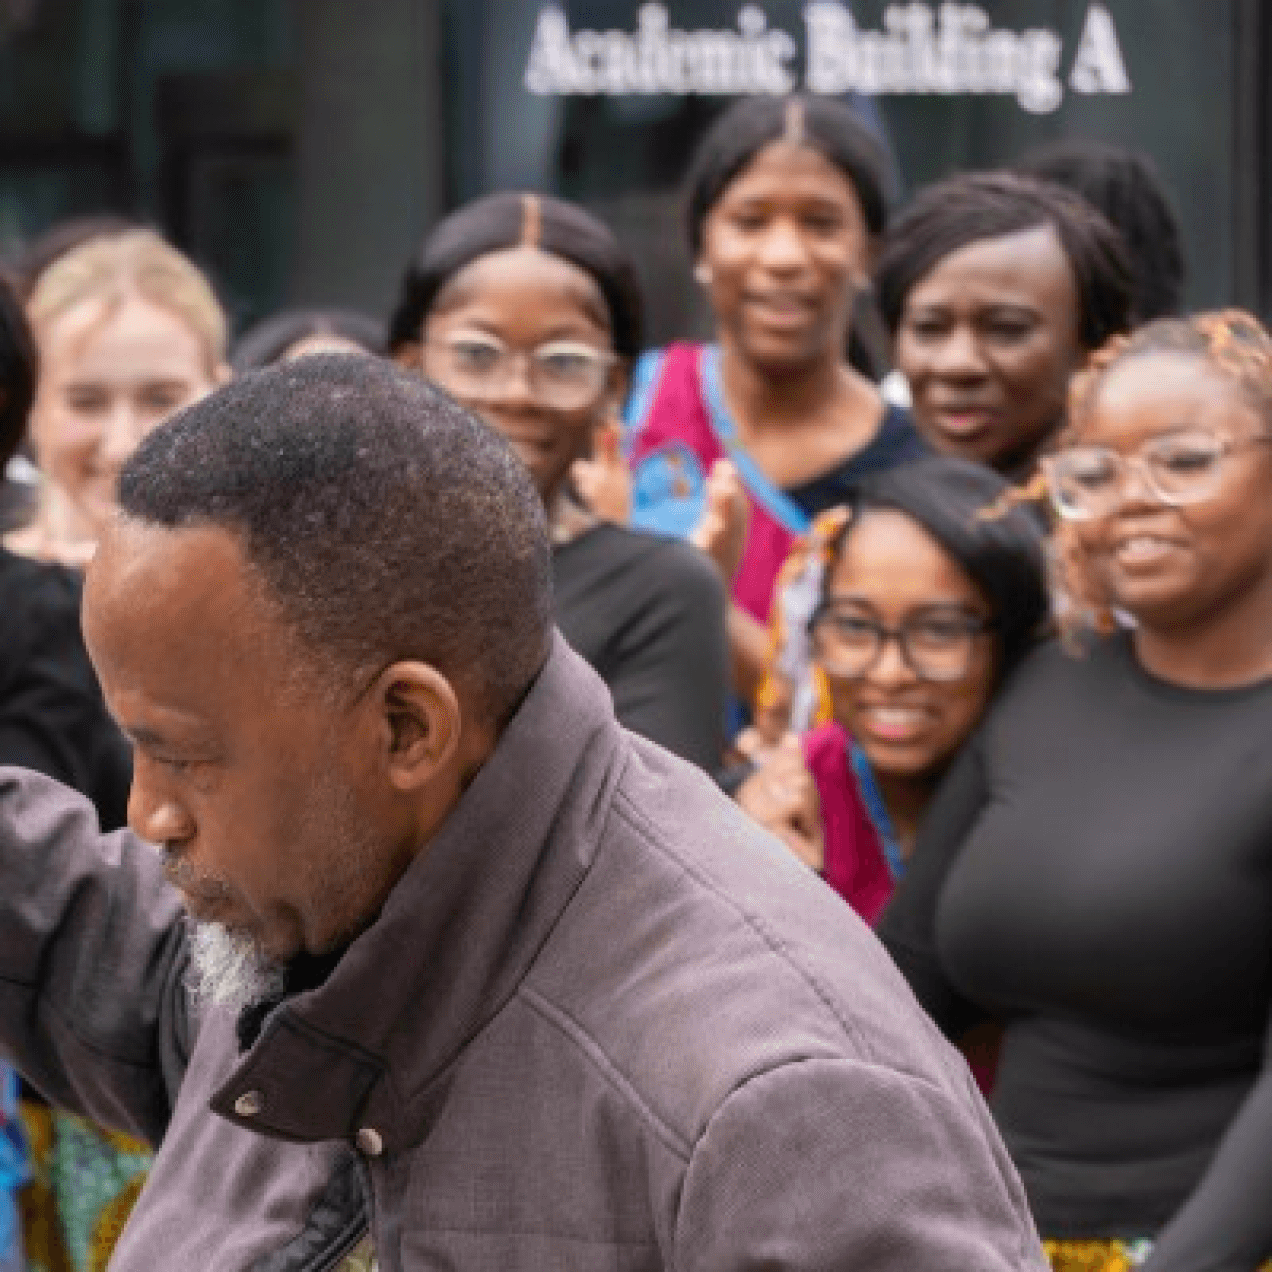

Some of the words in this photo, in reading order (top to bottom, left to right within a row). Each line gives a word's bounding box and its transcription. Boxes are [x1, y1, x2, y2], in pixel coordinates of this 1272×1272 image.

[524, 3, 797, 95] Academic
[802, 2, 1063, 113] Building
[1069, 3, 1132, 95] A
